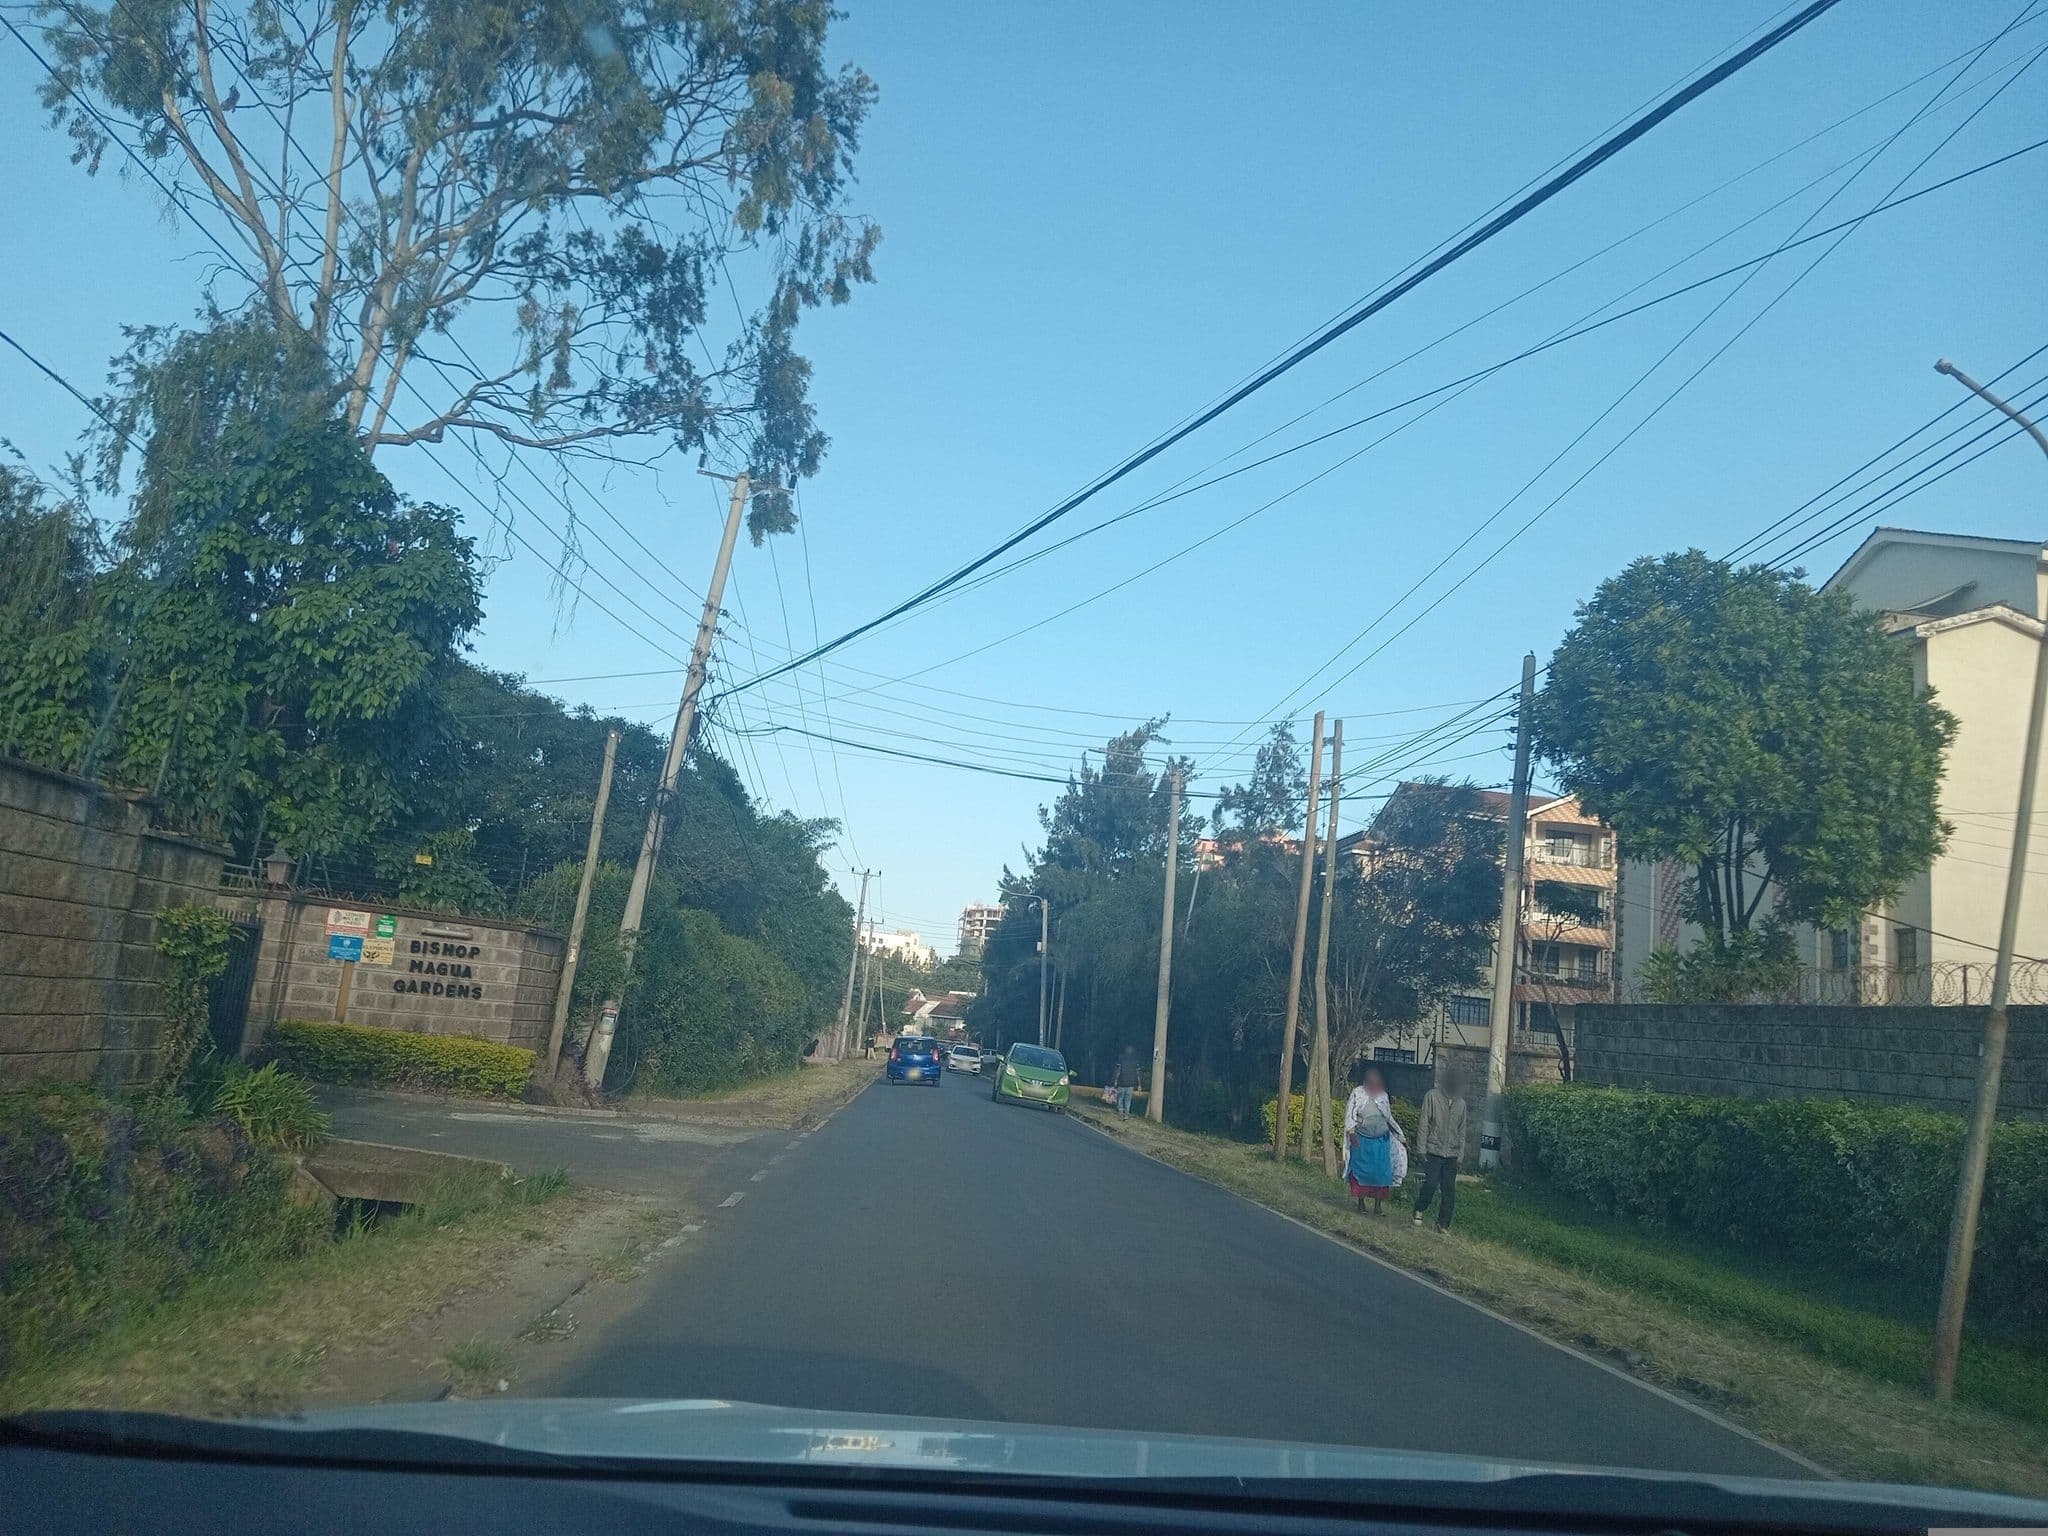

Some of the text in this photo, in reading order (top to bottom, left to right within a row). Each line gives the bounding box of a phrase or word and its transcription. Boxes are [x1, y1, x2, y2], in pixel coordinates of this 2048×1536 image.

[410, 940, 481, 959] BISHOP
[409, 960, 472, 979] MAGUA
[392, 979, 483, 1000] GARDENS
